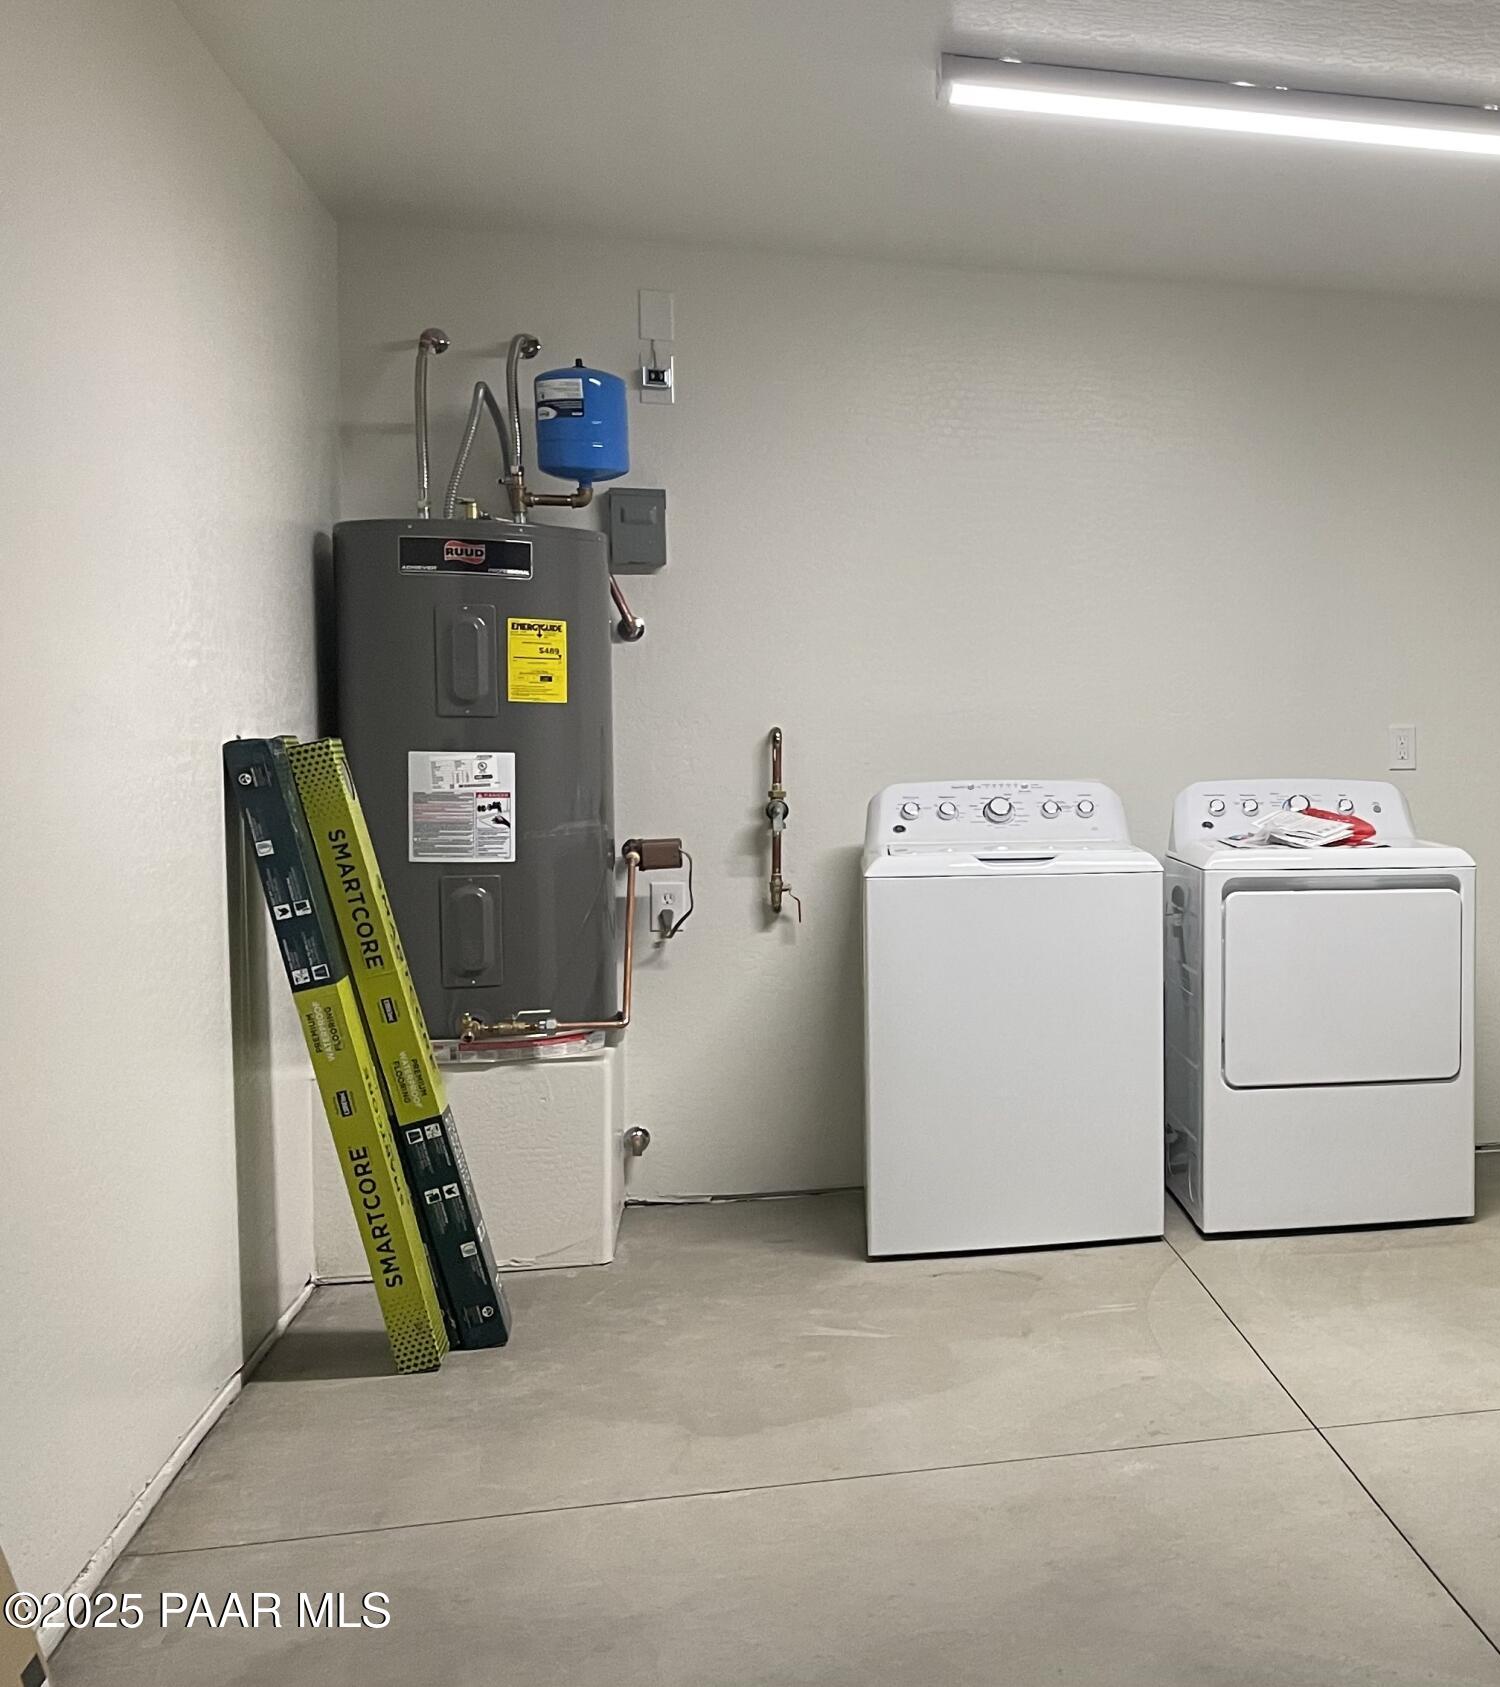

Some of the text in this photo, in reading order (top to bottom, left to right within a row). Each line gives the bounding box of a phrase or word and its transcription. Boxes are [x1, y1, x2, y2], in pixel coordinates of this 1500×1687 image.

[445, 547, 484, 557] RUUD
[328, 829, 385, 970] SMARTCORE
[306, 1013, 323, 1054] PREMIUM
[312, 1001, 336, 1062] WATERPROOF
[324, 1006, 342, 1052] FLOORING
[393, 1060, 411, 1105] FLOORING
[411, 1058, 428, 1097] PREMIUM
[349, 1146, 403, 1288] SMARTCORE
